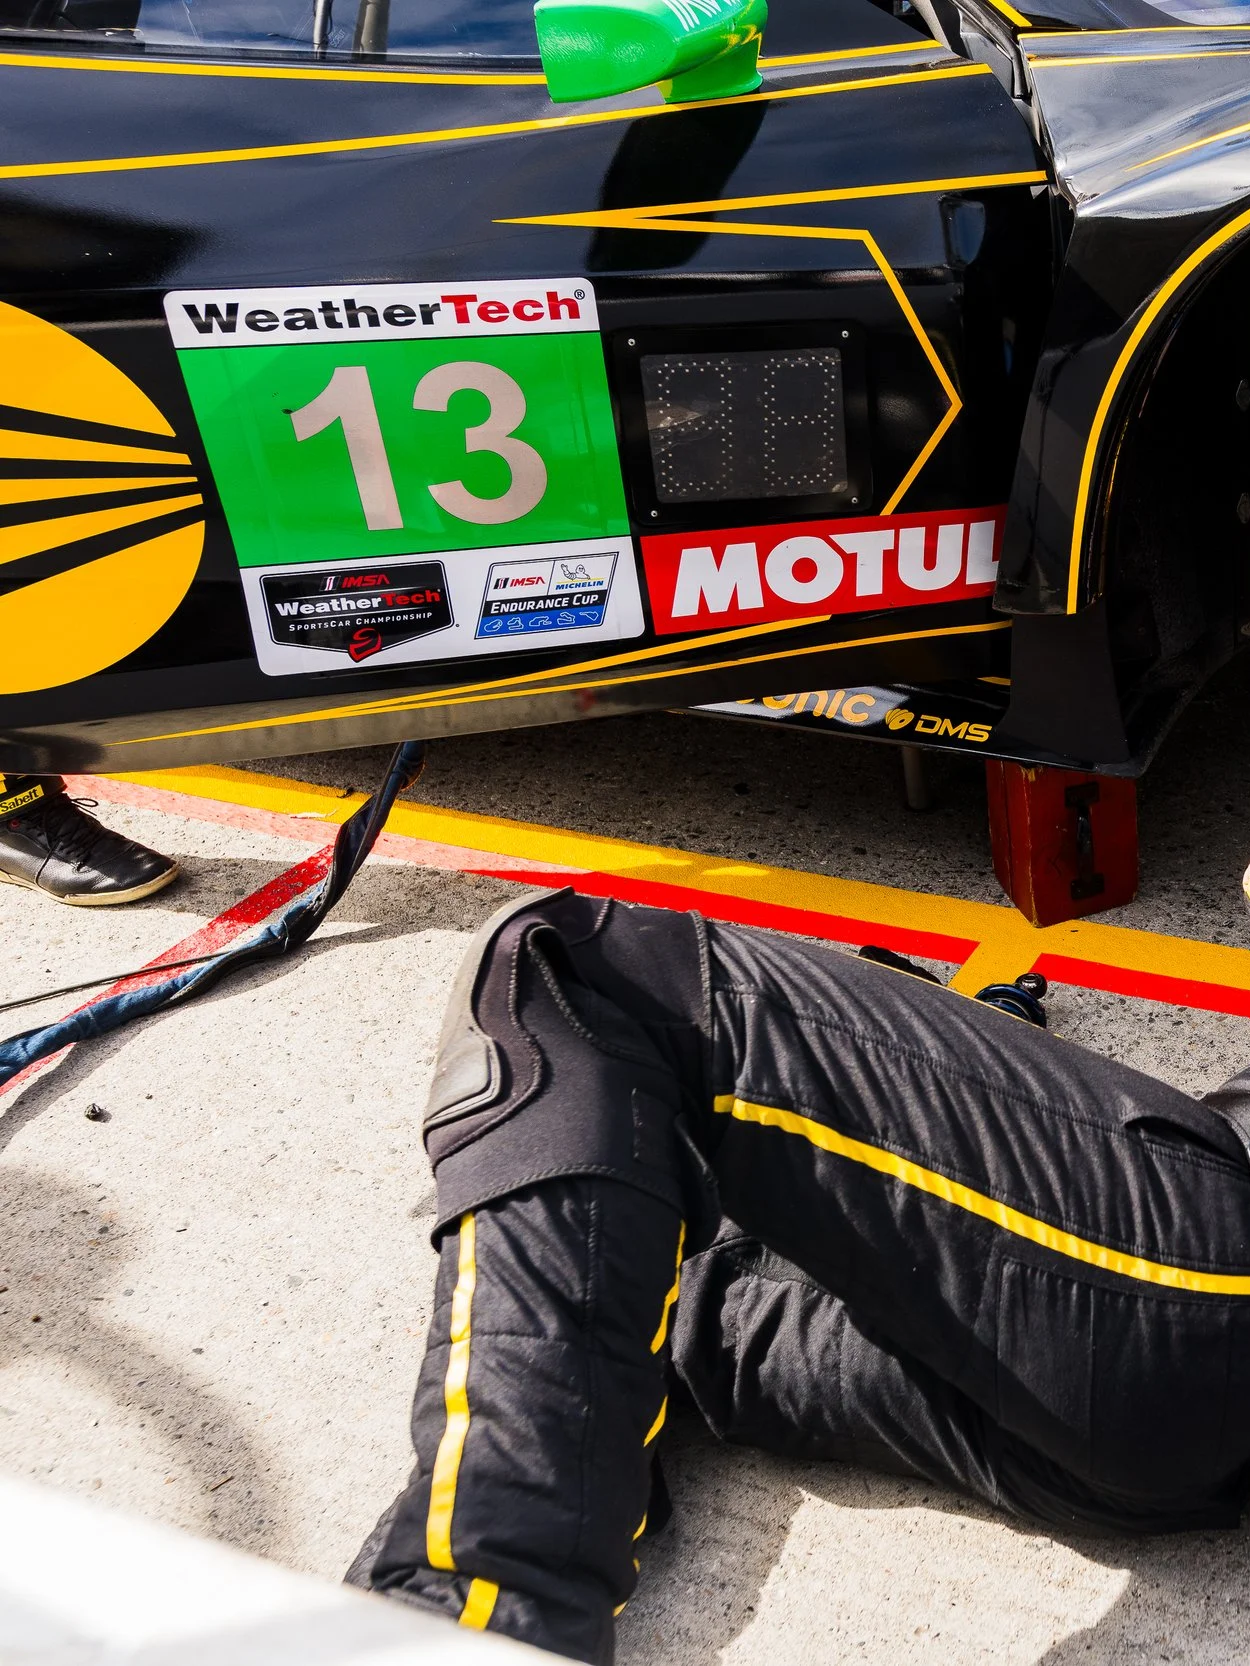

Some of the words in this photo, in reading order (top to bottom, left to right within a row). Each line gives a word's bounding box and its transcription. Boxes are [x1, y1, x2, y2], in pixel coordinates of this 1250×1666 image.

[290, 361, 548, 531] 13
[342, 574, 390, 588] IMSA
[671, 520, 999, 618] MOTUL
[510, 576, 546, 588] IMSA
[555, 580, 604, 591] MICHELIN
[914, 714, 993, 743] DMS
[0, 788, 39, 812] Sabelt
